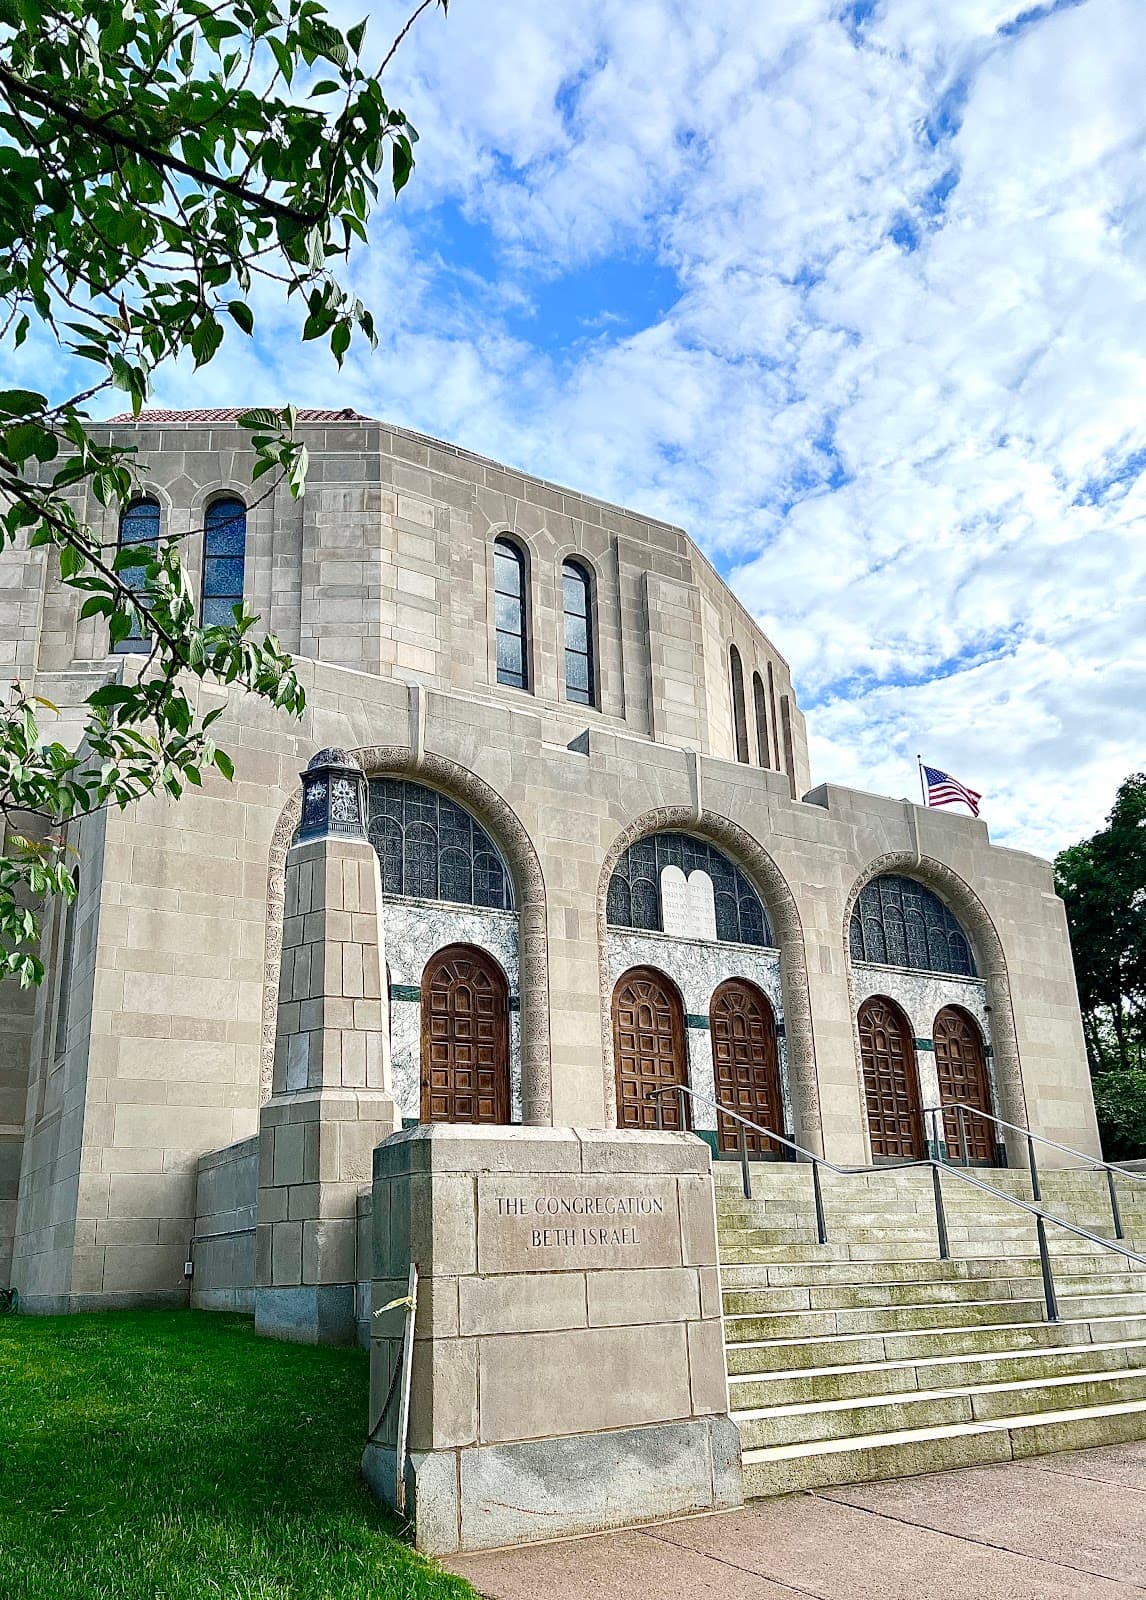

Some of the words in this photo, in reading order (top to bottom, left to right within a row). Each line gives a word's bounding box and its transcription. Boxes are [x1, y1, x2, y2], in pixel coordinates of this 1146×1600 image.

[495, 1197, 529, 1215] THE
[535, 1196, 664, 1215] CONGREGATION
[532, 1228, 576, 1247] BETH
[582, 1227, 641, 1246] ISRAEL
